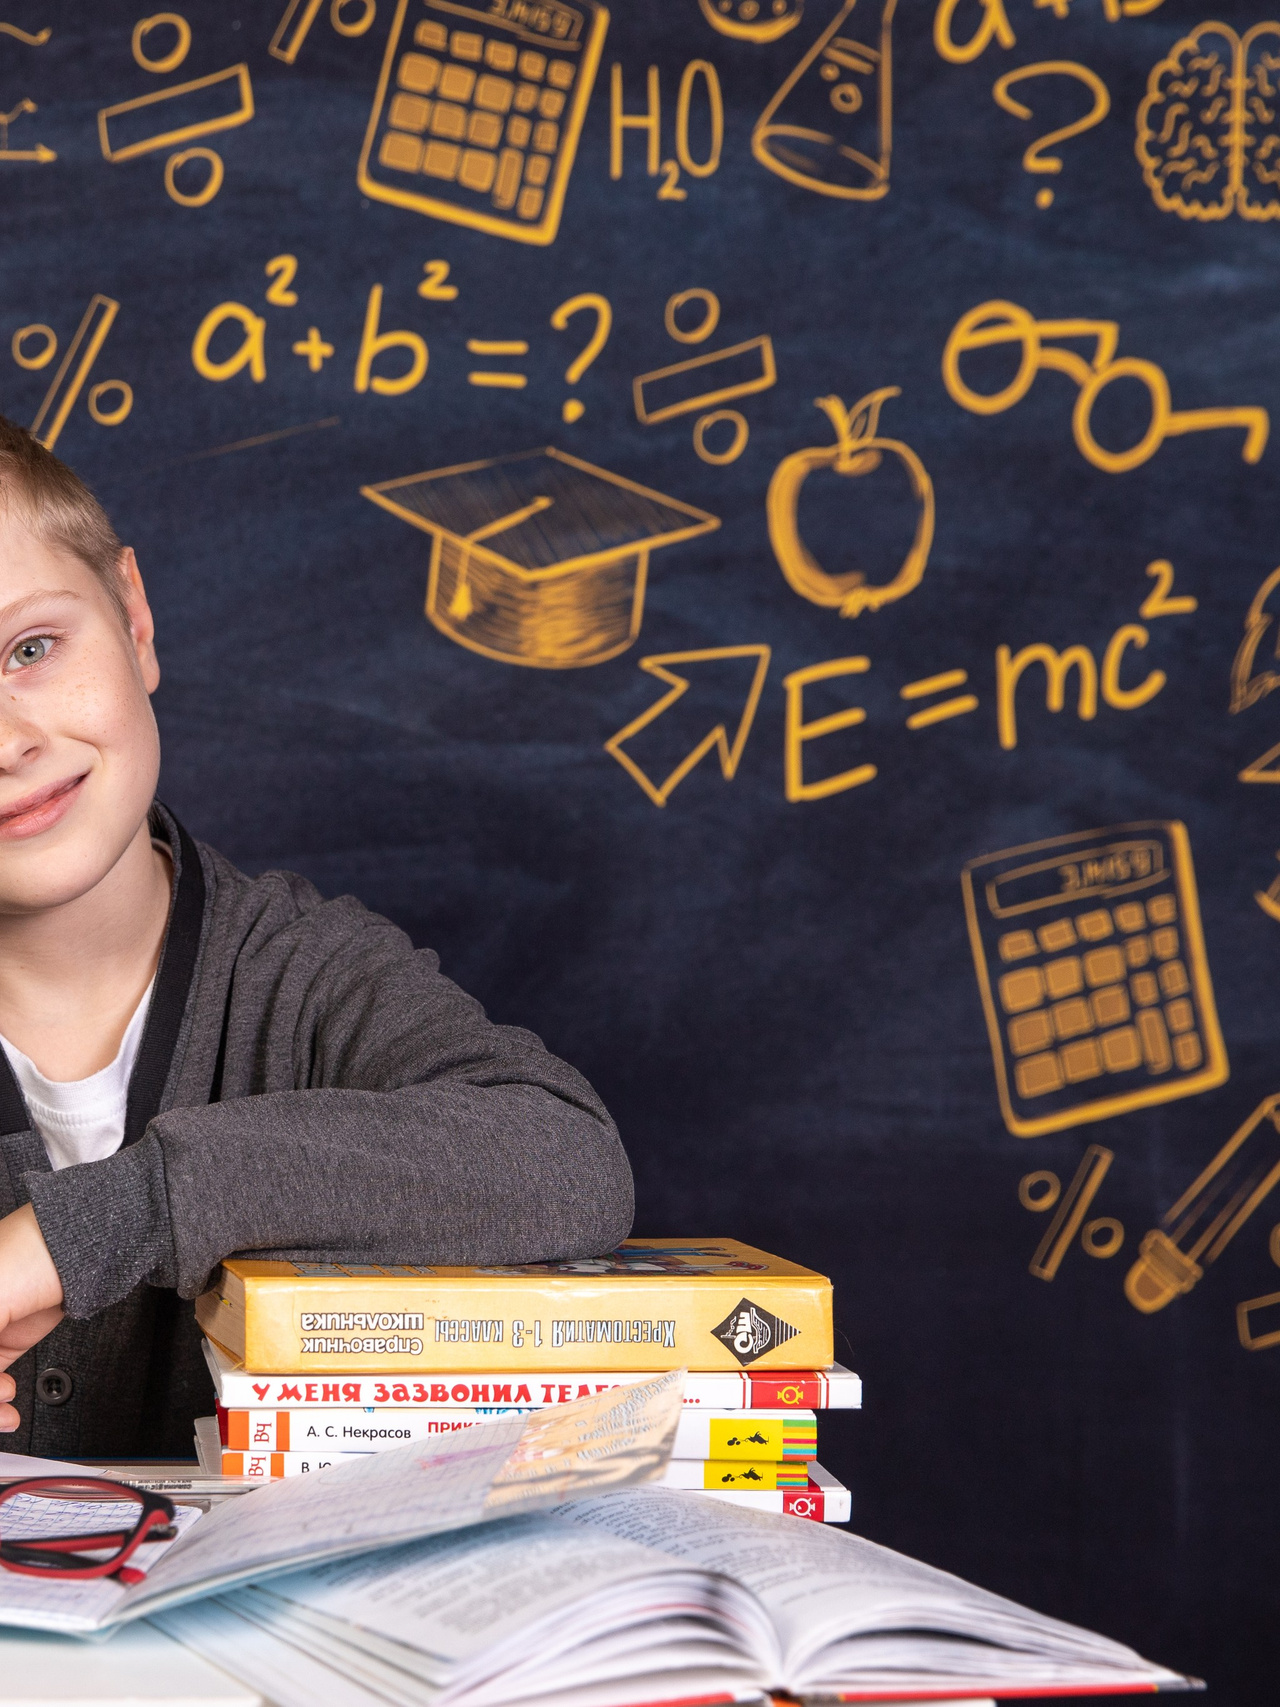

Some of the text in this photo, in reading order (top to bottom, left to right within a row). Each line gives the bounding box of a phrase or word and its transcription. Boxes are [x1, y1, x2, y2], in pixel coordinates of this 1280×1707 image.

[300, 1312, 425, 1331] школьника
[434, 1319, 504, 1343] КЛАССЫ
[511, 1319, 543, 1348] 1-3
[300, 1335, 424, 1356] Справочник
[251, 1383, 270, 1401] У
[277, 1383, 362, 1403] МЕНЯ
[306, 1425, 320, 1437] А.
[324, 1425, 338, 1438] С.
[343, 1426, 412, 1440] Некрасов
